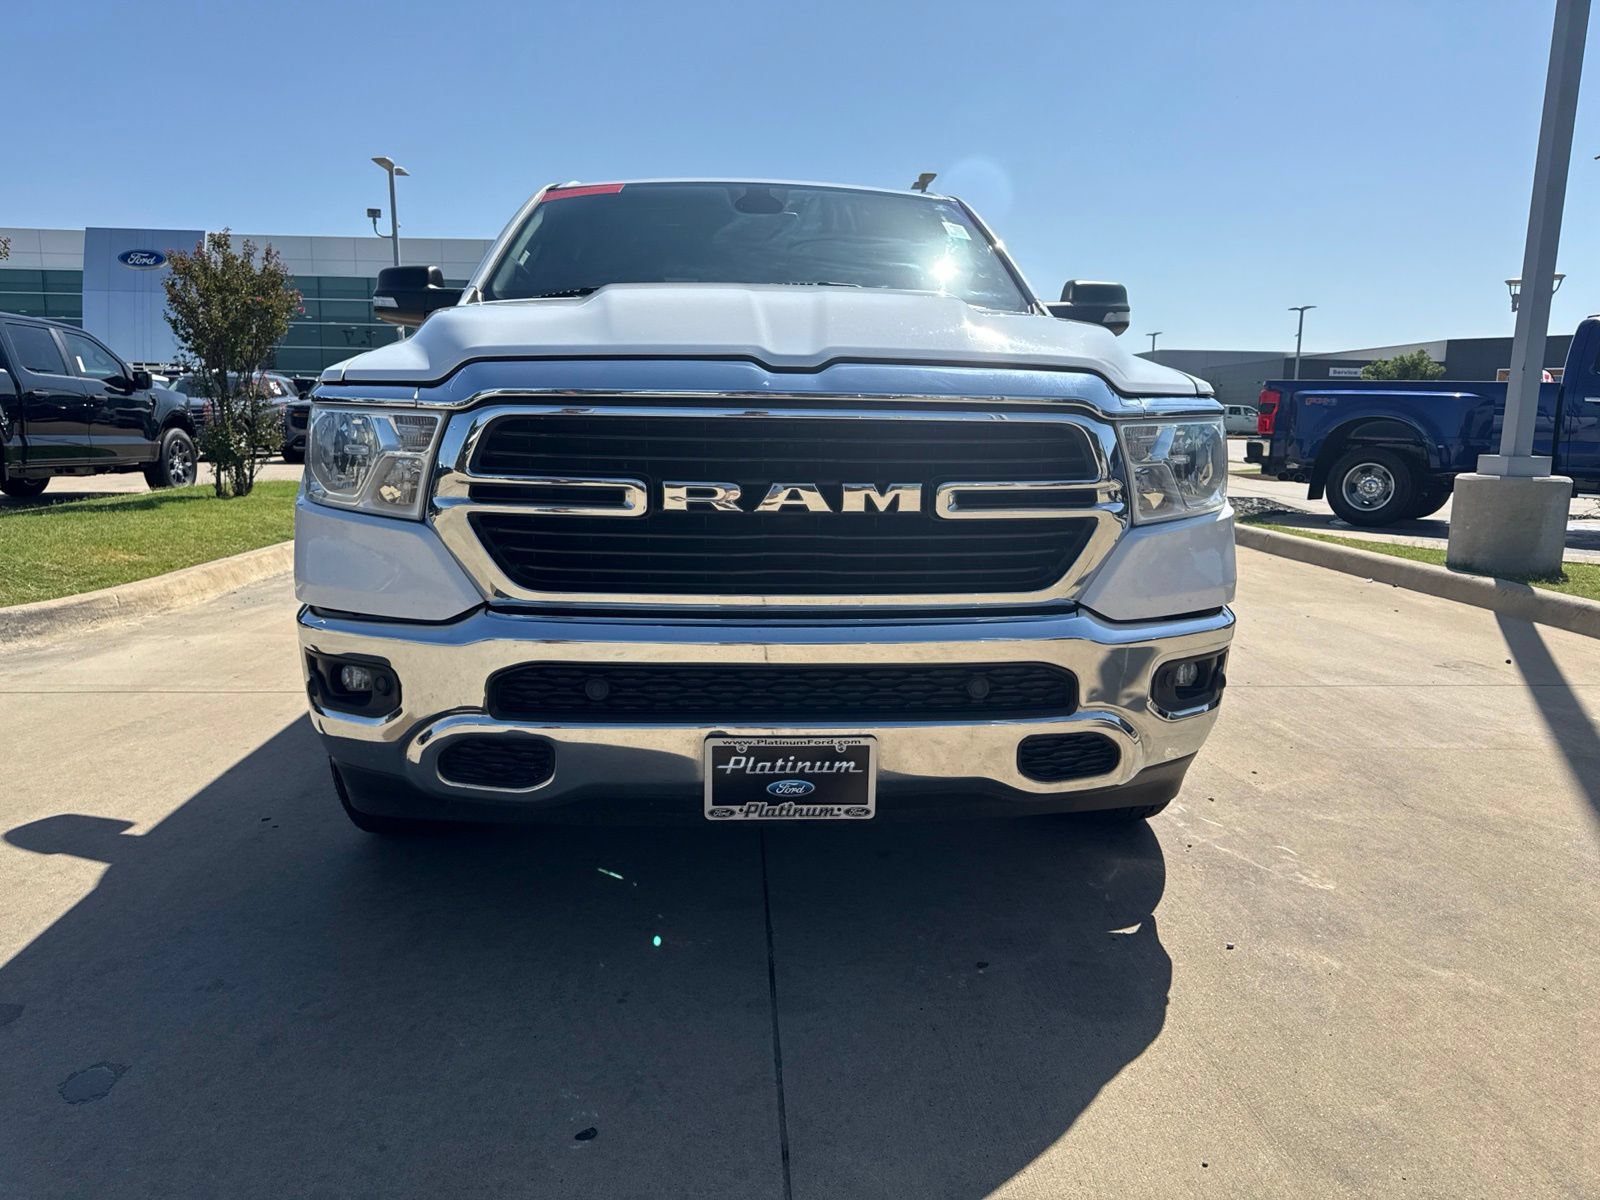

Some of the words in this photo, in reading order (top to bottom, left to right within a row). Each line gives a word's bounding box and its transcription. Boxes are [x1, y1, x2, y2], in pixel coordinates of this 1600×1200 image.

[127, 252, 156, 264] Ford
[662, 480, 922, 512] RAM
[717, 756, 863, 775] Platinum
[776, 782, 805, 794] Ford
[744, 802, 841, 817] Platinum
